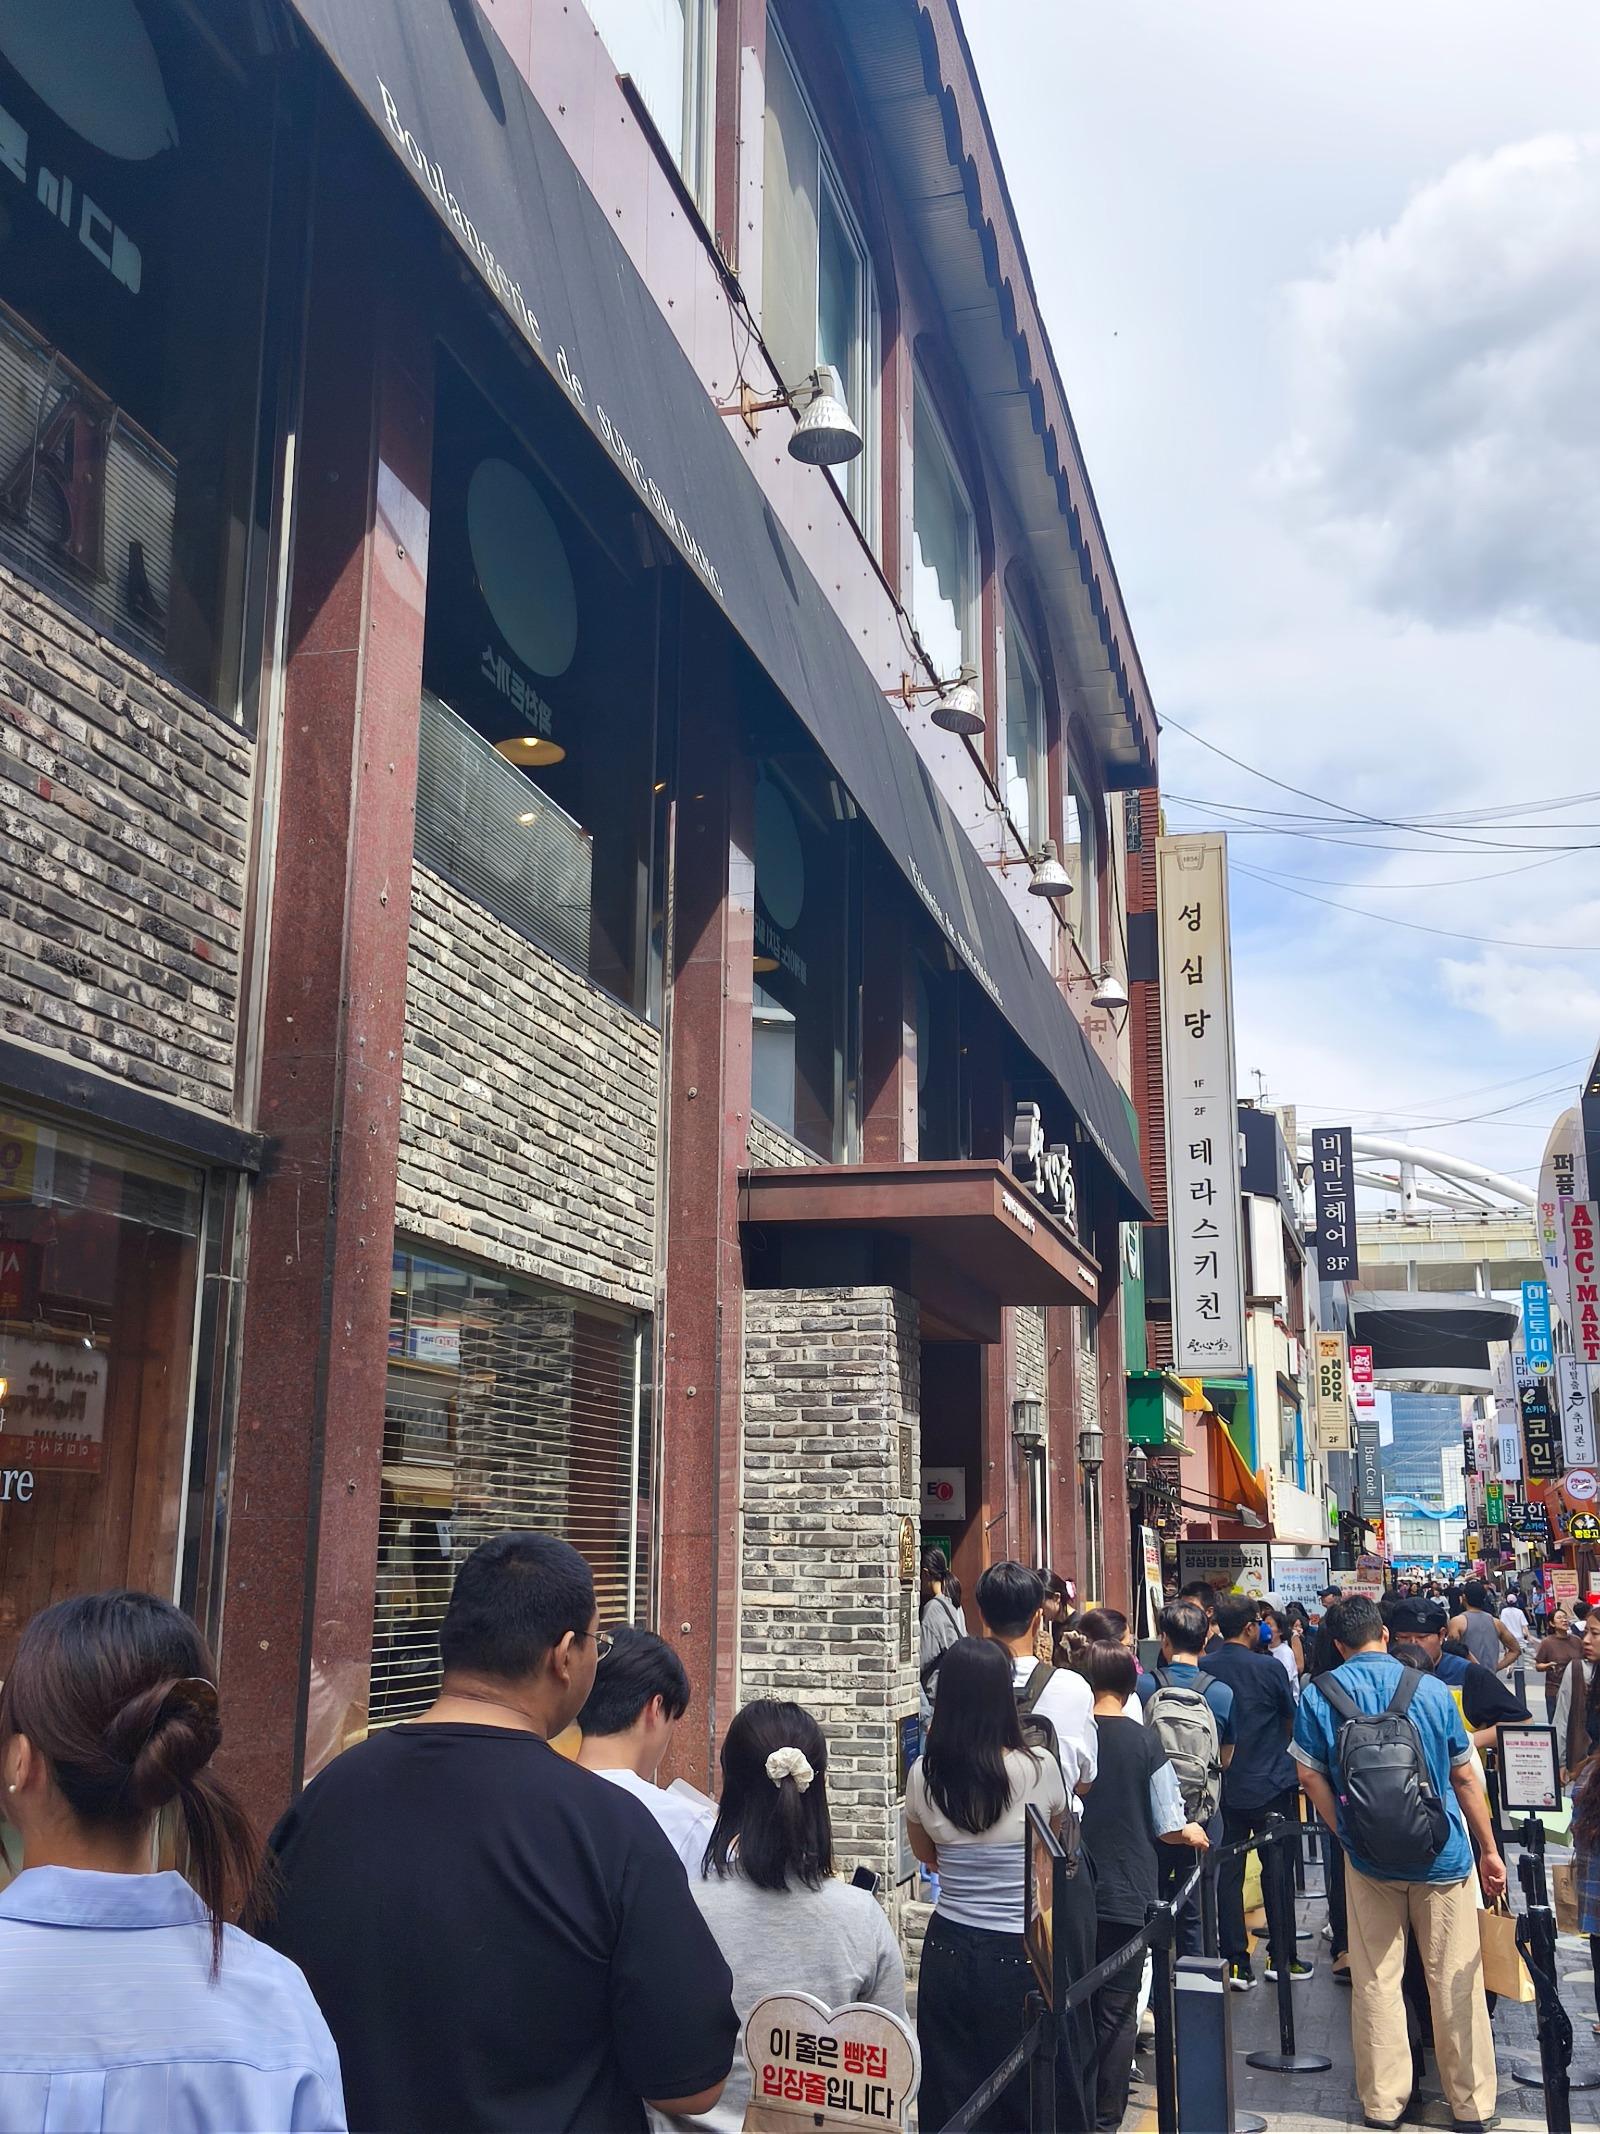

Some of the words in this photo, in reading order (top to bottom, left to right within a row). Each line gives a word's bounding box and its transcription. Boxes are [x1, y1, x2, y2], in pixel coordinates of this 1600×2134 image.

[377, 76, 541, 342] Boulangerie
[557, 345, 586, 406] de
[1178, 902, 1211, 1039] 성심당
[1194, 1079, 1205, 1089] 1F
[1194, 1106, 1206, 1116] 2F
[1320, 1133, 1347, 1248] 비바드헤어
[1187, 1137, 1221, 1320] 테라스키친
[1326, 1256, 1350, 1271] 3F
[1526, 1284, 1548, 1352] 히든토이
[1320, 1364, 1331, 1398] ODD
[1331, 1358, 1342, 1403] NOOK
[1525, 1405, 1547, 1414] 스카이
[1328, 1435, 1340, 1443] 2F
[1528, 1418, 1552, 1465] 코인
[0, 1470, 34, 1502] re
[1511, 1504, 1543, 1521] 코인
[1185, 1556, 1217, 1568] 성심당
[1231, 1556, 1264, 1568] 브런치
[770, 2027, 790, 2060] 이
[795, 2031, 839, 2069] 줄은
[844, 2040, 887, 2079] 빵집
[762, 2064, 895, 2119] 입장줄입니다
